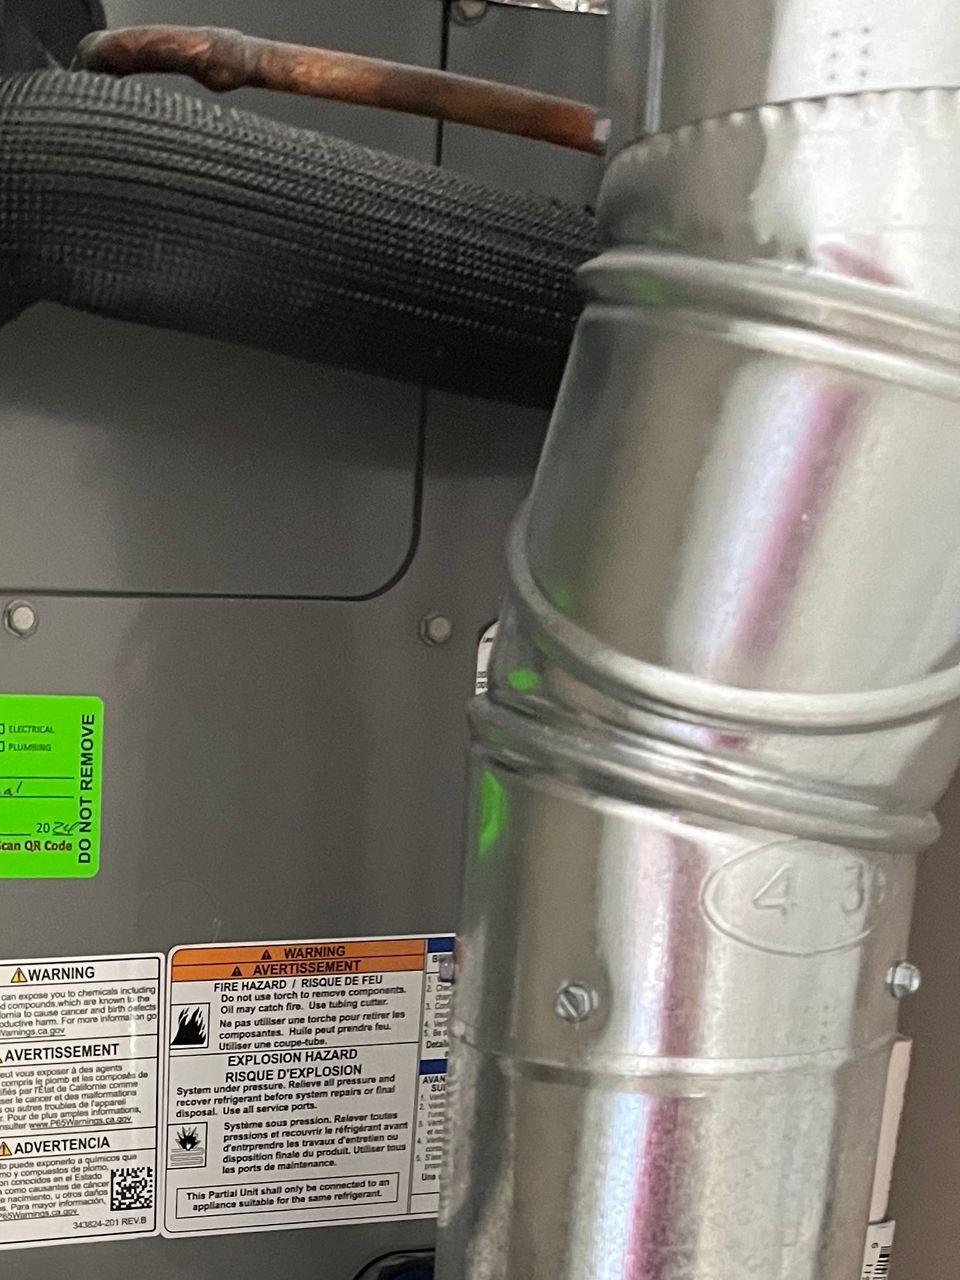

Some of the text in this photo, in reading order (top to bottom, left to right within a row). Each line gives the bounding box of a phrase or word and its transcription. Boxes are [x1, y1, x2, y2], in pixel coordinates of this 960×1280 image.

[8, 725, 55, 735] ELECTRICAL
[8, 742, 52, 752] PLUMBING
[78, 713, 95, 864] DO NOT REMOVE
[24, 840, 40, 852] QR
[44, 840, 73, 851] Code
[284, 947, 345, 959] WARNING
[28, 967, 95, 981] WARNING
[253, 960, 361, 976] AVERTISSEMENT
[214, 975, 383, 992] FIRE HAZARD / RISQUE DE FEU
[18, 993, 48, 1002] expose
[67, 990, 76, 998] to
[77, 989, 118, 998] chemicals
[120, 987, 156, 997] including
[98, 996, 125, 1004] known
[136, 994, 150, 1002] the
[220, 994, 234, 1002] Do
[236, 993, 252, 1002] not
[273, 991, 298, 1000] torch
[300, 990, 309, 998] to
[311, 990, 346, 998] remove
[348, 985, 407, 998] components.
[220, 1006, 233, 1014] Oil
[236, 1006, 255, 1015] may
[258, 1003, 283, 1012] catch
[286, 1002, 304, 1010] fire.
[308, 1001, 326, 1009] Use
[328, 1000, 358, 1010] tubing
[4, 1044, 119, 1061] AVERTISSEMENT
[218, 1041, 251, 1050] Utiliser
[273, 1038, 327, 1049] coupe-tube.
[227, 1049, 358, 1066] EXPLOSION HAZARD
[225, 1064, 362, 1085] RISQUE D'EXPLOSION
[176, 1074, 395, 1096] System under pressure. Relieve all pressure and
[213, 1094, 261, 1106] refrigerant
[264, 1092, 293, 1101] before
[295, 1090, 328, 1101] system
[330, 1088, 361, 1098] repairs
[375, 1085, 396, 1094] final
[176, 1101, 318, 1119] disposal. Use all service ports.
[224, 1120, 263, 1131] Système
[290, 1115, 331, 1127] pression.
[333, 1113, 368, 1122] Relever
[369, 1111, 398, 1120] toutes
[14, 1137, 110, 1154] ADVERTENCIA
[222, 1158, 337, 1174] les ports de maintenance.
[187, 1191, 205, 1200] This
[208, 1189, 237, 1198] Partial
[239, 1187, 258, 1196] Unit
[260, 1186, 282, 1194] shall
[284, 1184, 303, 1195] only
[305, 1183, 317, 1191] be
[318, 1180, 366, 1190] connected
[367, 1179, 377, 1187] to
[192, 1189, 383, 1212] appliance suitable for the same refrigerant.
